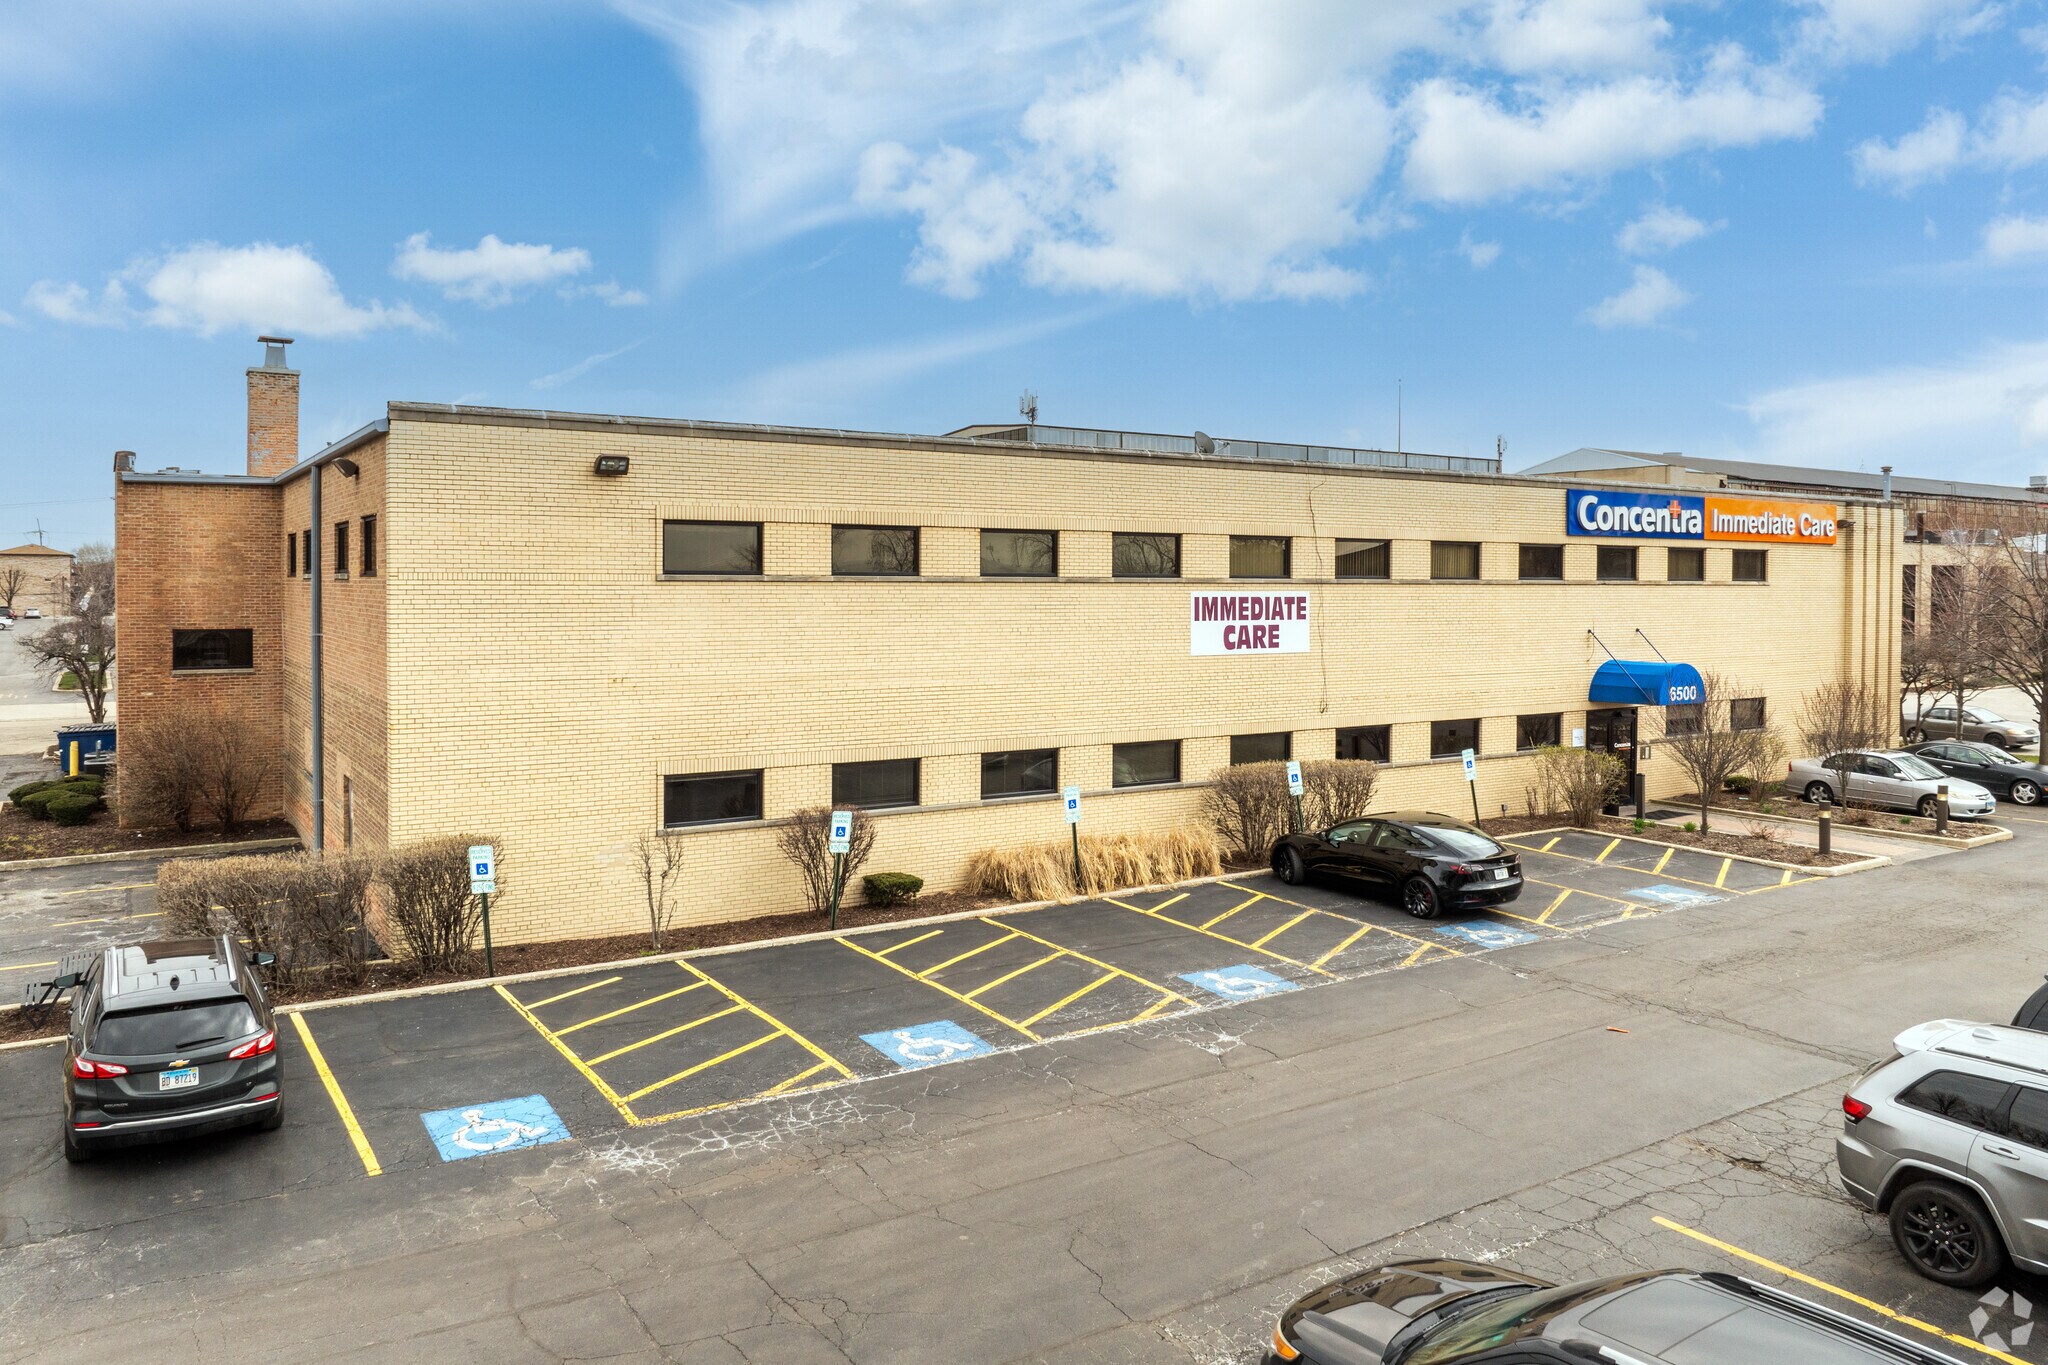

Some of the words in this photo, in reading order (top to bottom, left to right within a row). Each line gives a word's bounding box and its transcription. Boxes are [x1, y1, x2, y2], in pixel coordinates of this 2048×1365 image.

[1577, 495, 1702, 534] Concentra
[1712, 507, 1796, 535] Immediate
[1799, 512, 1835, 537] Care
[1194, 596, 1307, 621] IMMEDIATE
[1223, 624, 1280, 650] CARE
[1670, 685, 1697, 701] 6500
[174, 1072, 197, 1085] 87219
